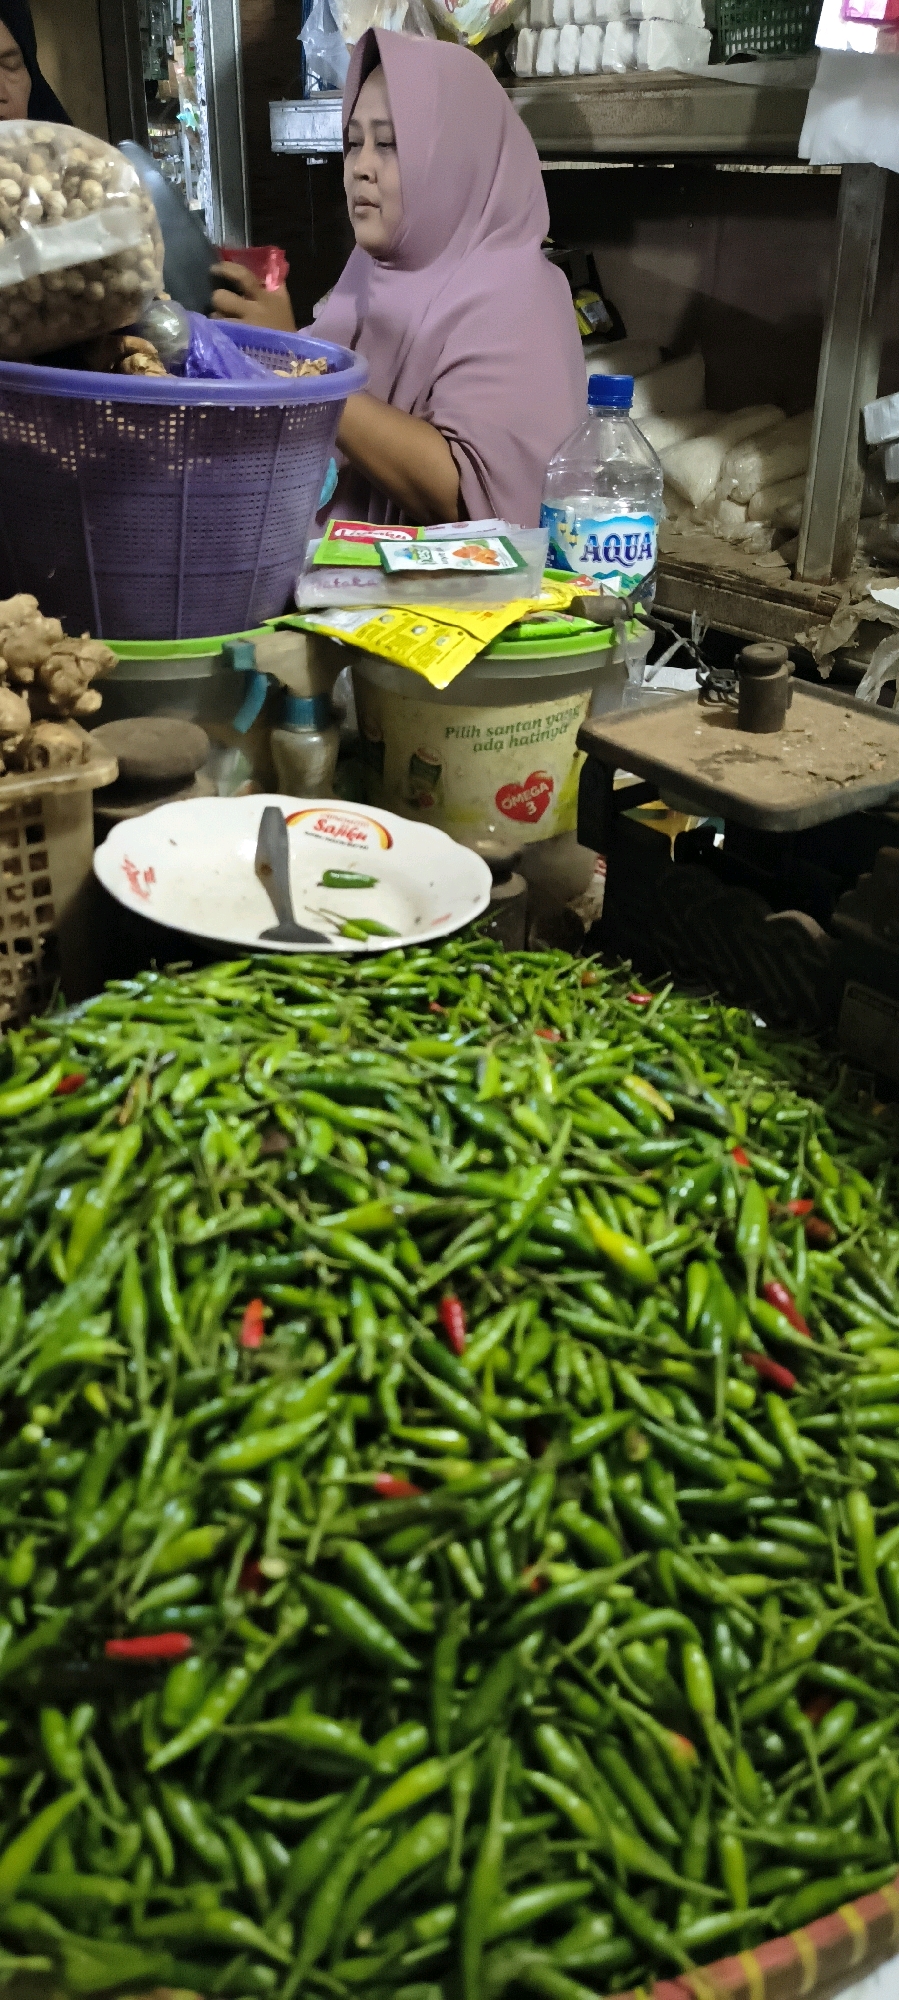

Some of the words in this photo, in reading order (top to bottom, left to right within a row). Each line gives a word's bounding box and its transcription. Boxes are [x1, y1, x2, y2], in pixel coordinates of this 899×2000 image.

[579, 532, 653, 568] AQUA
[445, 725, 481, 739] Pilih
[485, 718, 542, 737] santan
[546, 704, 581, 726] yang
[473, 737, 505, 752] ada
[509, 723, 570, 748] hatinya
[501, 782, 550, 810] OMEGA
[526, 801, 537, 815] 3
[313, 818, 367, 843] Sajiku
